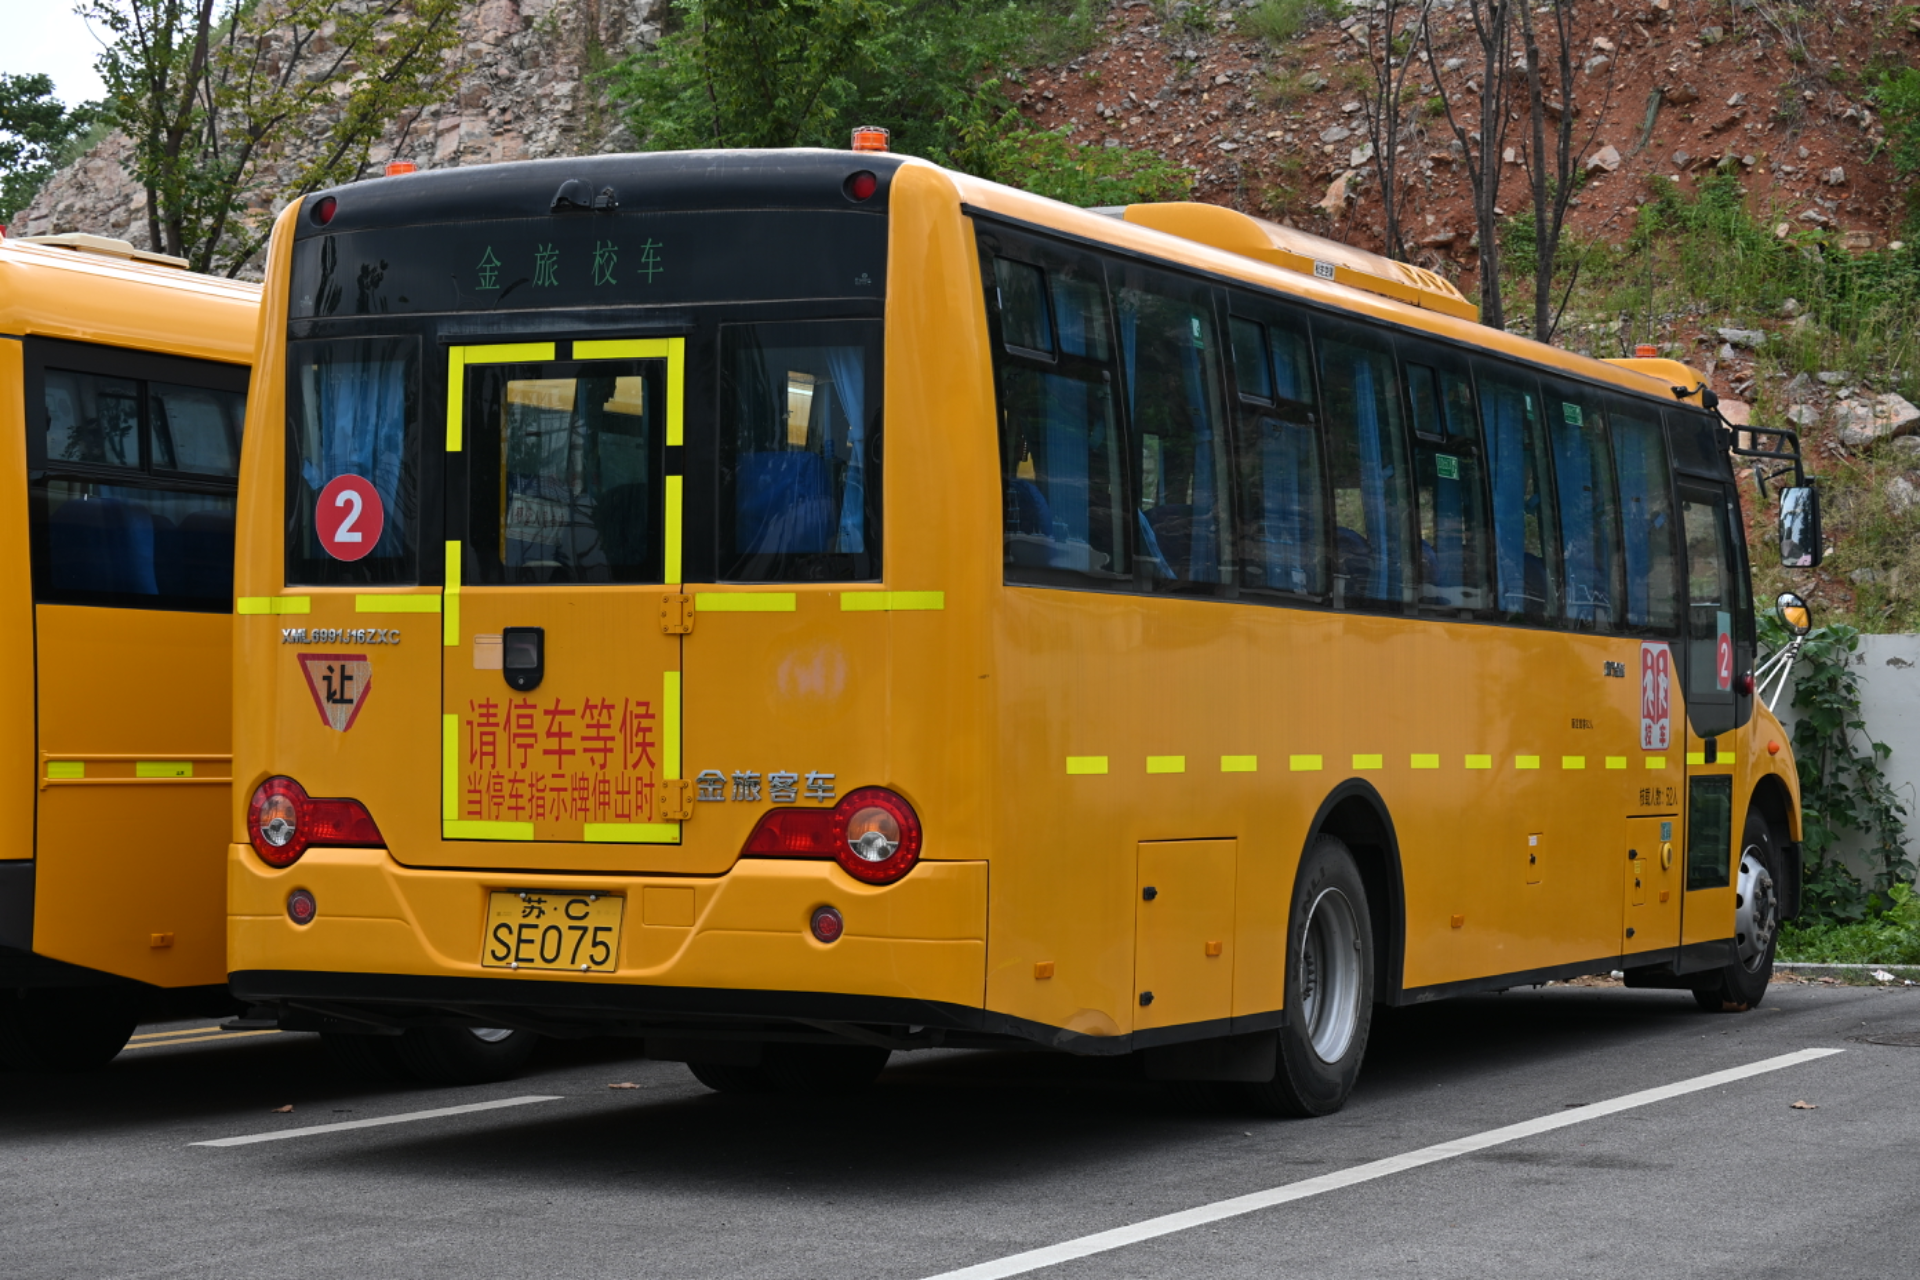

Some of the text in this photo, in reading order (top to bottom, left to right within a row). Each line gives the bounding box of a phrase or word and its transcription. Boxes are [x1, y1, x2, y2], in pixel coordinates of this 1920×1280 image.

[475, 238, 664, 291] 金旅校车
[334, 489, 363, 543] 2
[1721, 642, 1729, 677] 2
[322, 664, 354, 704] 让
[466, 697, 657, 771] 请停车等候
[466, 771, 656, 822] 当停车指示牌伸出时
[695, 770, 836, 803] 金旅客车
[491, 922, 613, 966] SE075
